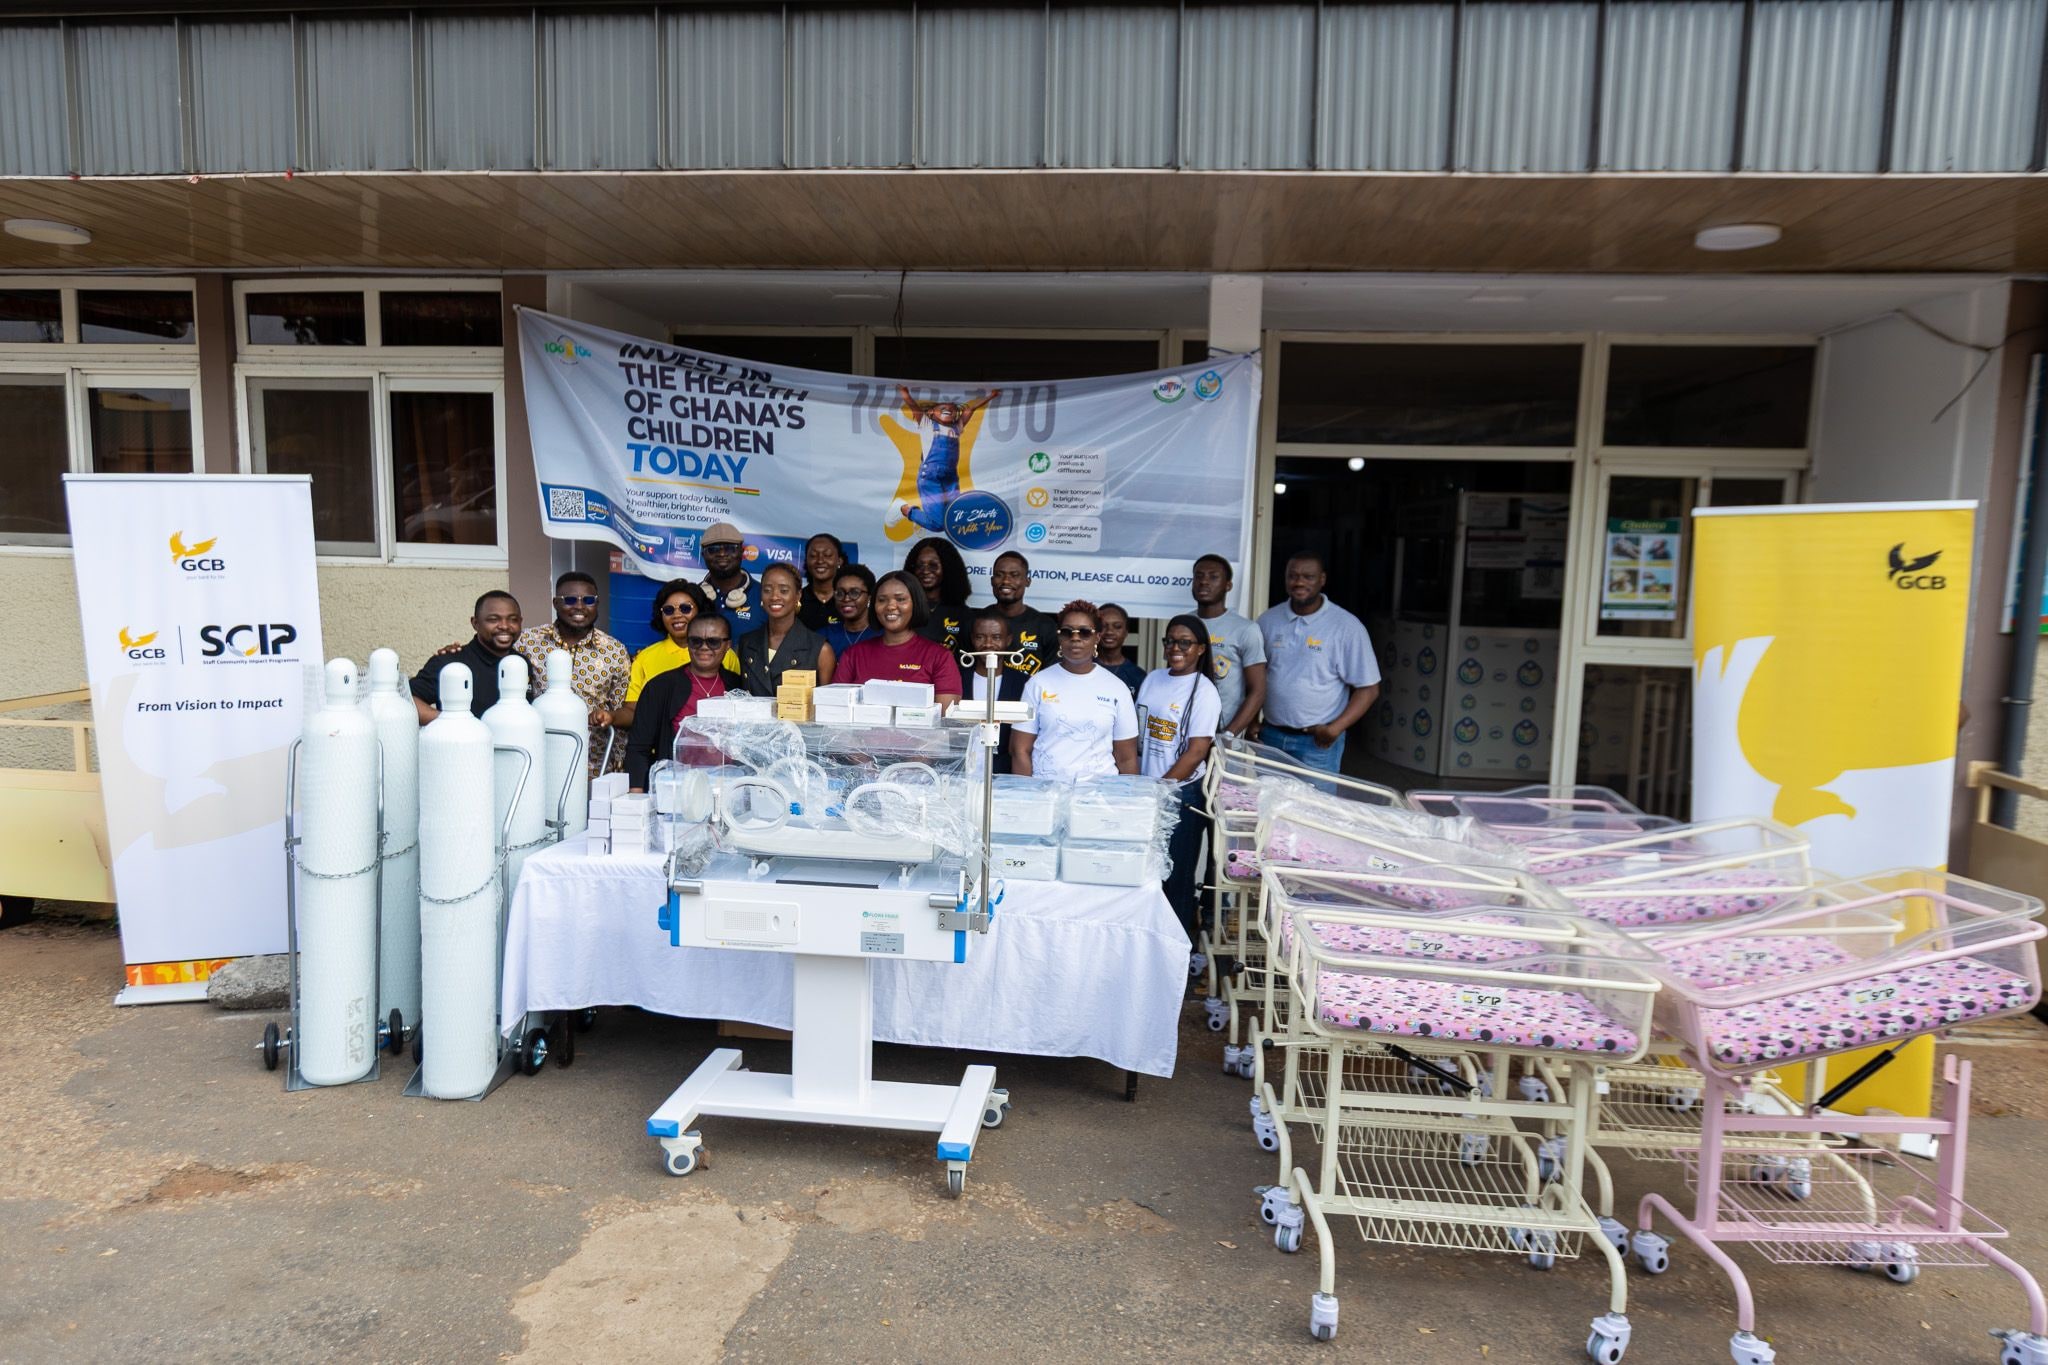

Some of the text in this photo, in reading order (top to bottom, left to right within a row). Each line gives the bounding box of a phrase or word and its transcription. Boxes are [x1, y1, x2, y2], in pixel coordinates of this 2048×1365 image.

[619, 343, 772, 383] INVEST IN
[618, 361, 810, 402] THE HEALTH
[623, 389, 806, 430] OF GHANA'S
[627, 416, 775, 455] CHILDREN
[626, 443, 749, 484] TODAY
[625, 487, 728, 505] Your support today builds
[626, 505, 635, 514] for
[636, 508, 685, 521] generations
[686, 513, 696, 521] to
[631, 499, 670, 511] healthier,
[671, 503, 703, 514] brighter
[705, 504, 730, 515] future
[766, 548, 793, 561] VISA
[181, 559, 225, 571] GCB
[966, 566, 987, 575] ORE
[1071, 571, 1113, 583] PLEASE
[1116, 573, 1145, 584] CALL
[1147, 575, 1170, 586] 020
[1171, 576, 1193, 587] 207
[1896, 575, 1947, 590] GCB
[200, 623, 297, 657] SCIP
[128, 648, 166, 660] GCB
[137, 698, 283, 713] From Vision to Impact
